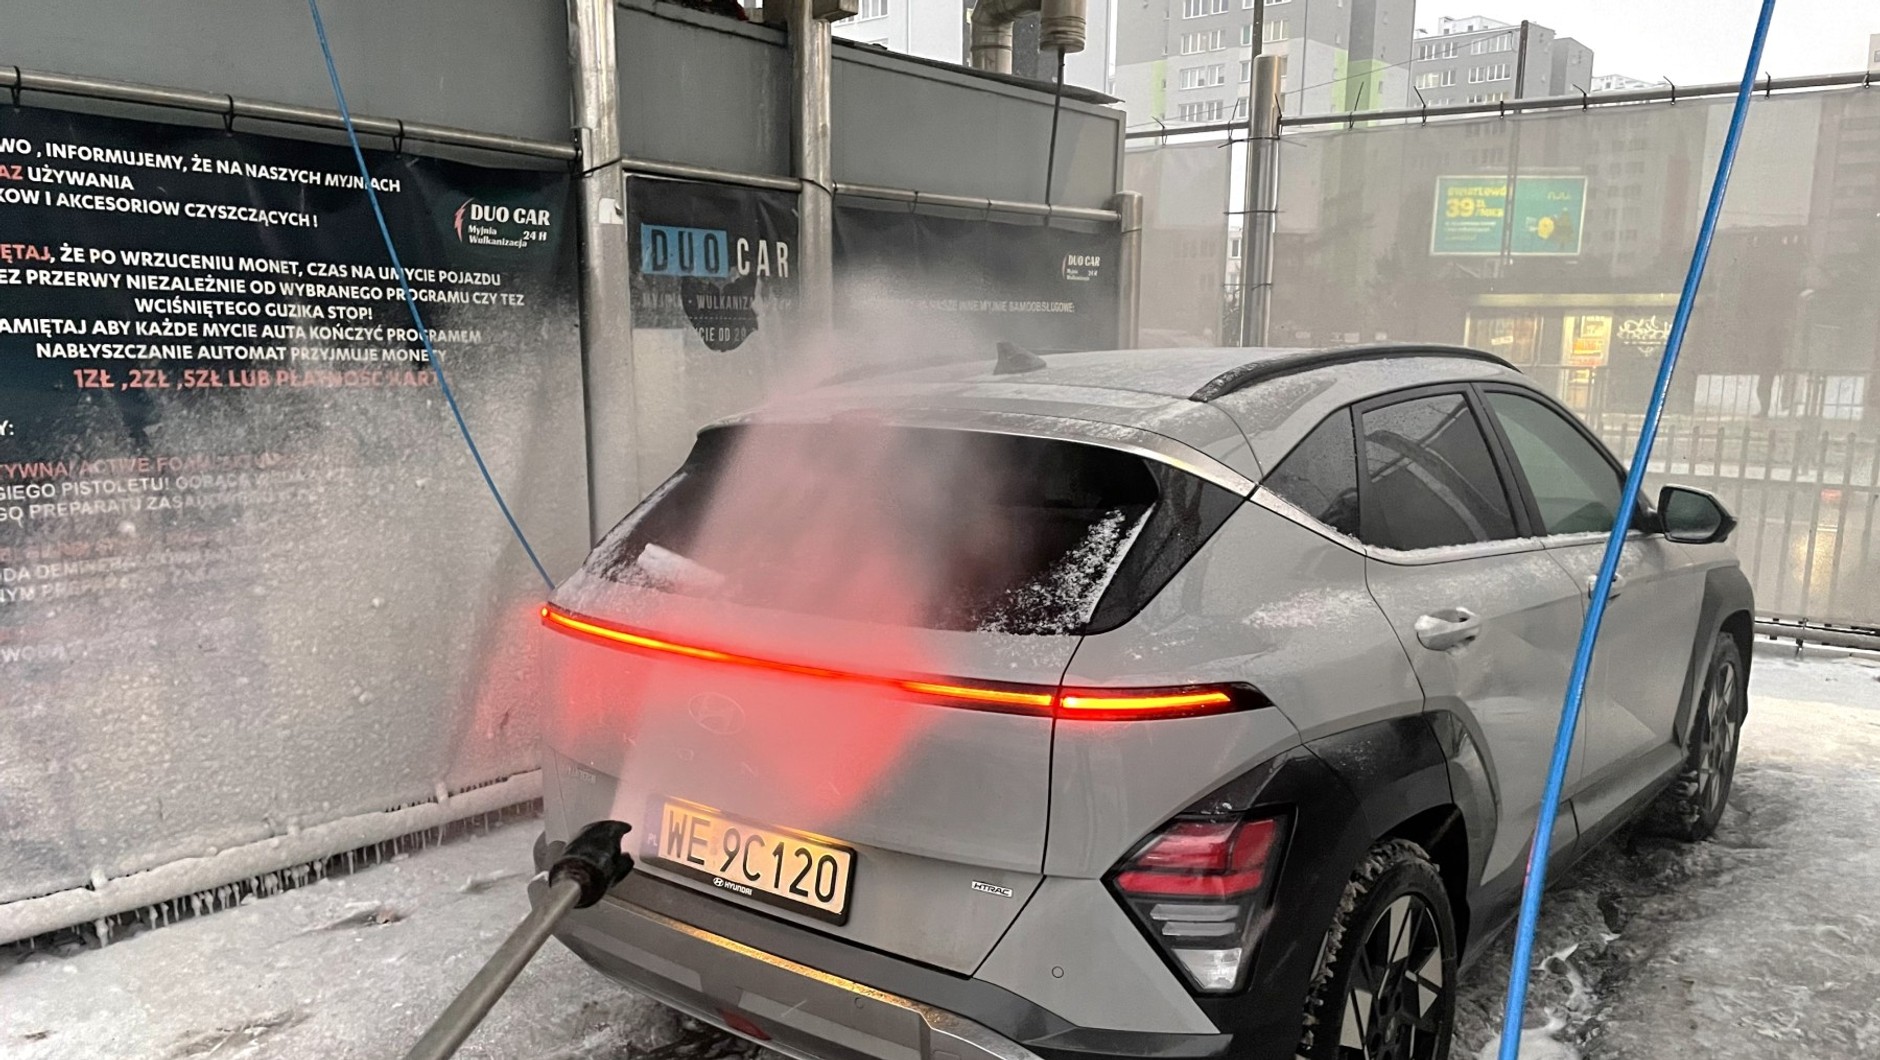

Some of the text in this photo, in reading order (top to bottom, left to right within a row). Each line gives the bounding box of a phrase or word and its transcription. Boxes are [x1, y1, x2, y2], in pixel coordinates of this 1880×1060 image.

[45, 142, 188, 173] INFORMUJEMY,
[191, 154, 213, 174] ŻE
[216, 160, 243, 176] NA
[245, 163, 320, 186] NASZYCH
[27, 163, 135, 191] UŻYWANIA
[45, 191, 51, 206] I
[56, 192, 180, 216] AKCESORIOW
[470, 203, 551, 226] DUO CAR
[468, 224, 498, 236] Myjnia
[468, 234, 528, 249] Wulkanizacja
[522, 230, 537, 241] 24
[60, 242, 85, 262] ŻE
[90, 248, 116, 264] PO
[120, 250, 234, 271] WRZUCENIU
[238, 258, 303, 277] MONET,
[307, 262, 348, 278] CZAS
[351, 265, 375, 279] NA
[438, 270, 501, 286] POJAZDU
[651, 228, 790, 279] DUO CAR
[26, 269, 121, 288] PRZERWY
[126, 273, 246, 294] NIEZALEŻNIE
[250, 280, 276, 295] OD
[279, 282, 383, 301] WYBRANEGO
[472, 292, 498, 305] CZY
[134, 295, 373, 321] WCIŚNIĘTEGO GUZIKA STOP!
[91, 320, 131, 336] ABY
[135, 317, 198, 337] KAŻDE
[202, 323, 257, 338] MYCIE
[261, 324, 305, 339] AUTA
[309, 323, 384, 341] KOŃCZYĆ
[36, 343, 447, 363] NABŁYSZCZANIE AUTOMAT PRZYJMUJE MONEY
[73, 368, 115, 388] 1ZŁ
[228, 371, 272, 388] LUB
[61, 477, 170, 498] PISTOLETU!
[29, 496, 142, 520] PREPARATU
[666, 809, 839, 904] WE 9C120
[724, 881, 753, 896] HYUNDAI
[972, 881, 1011, 897] HTRAC
